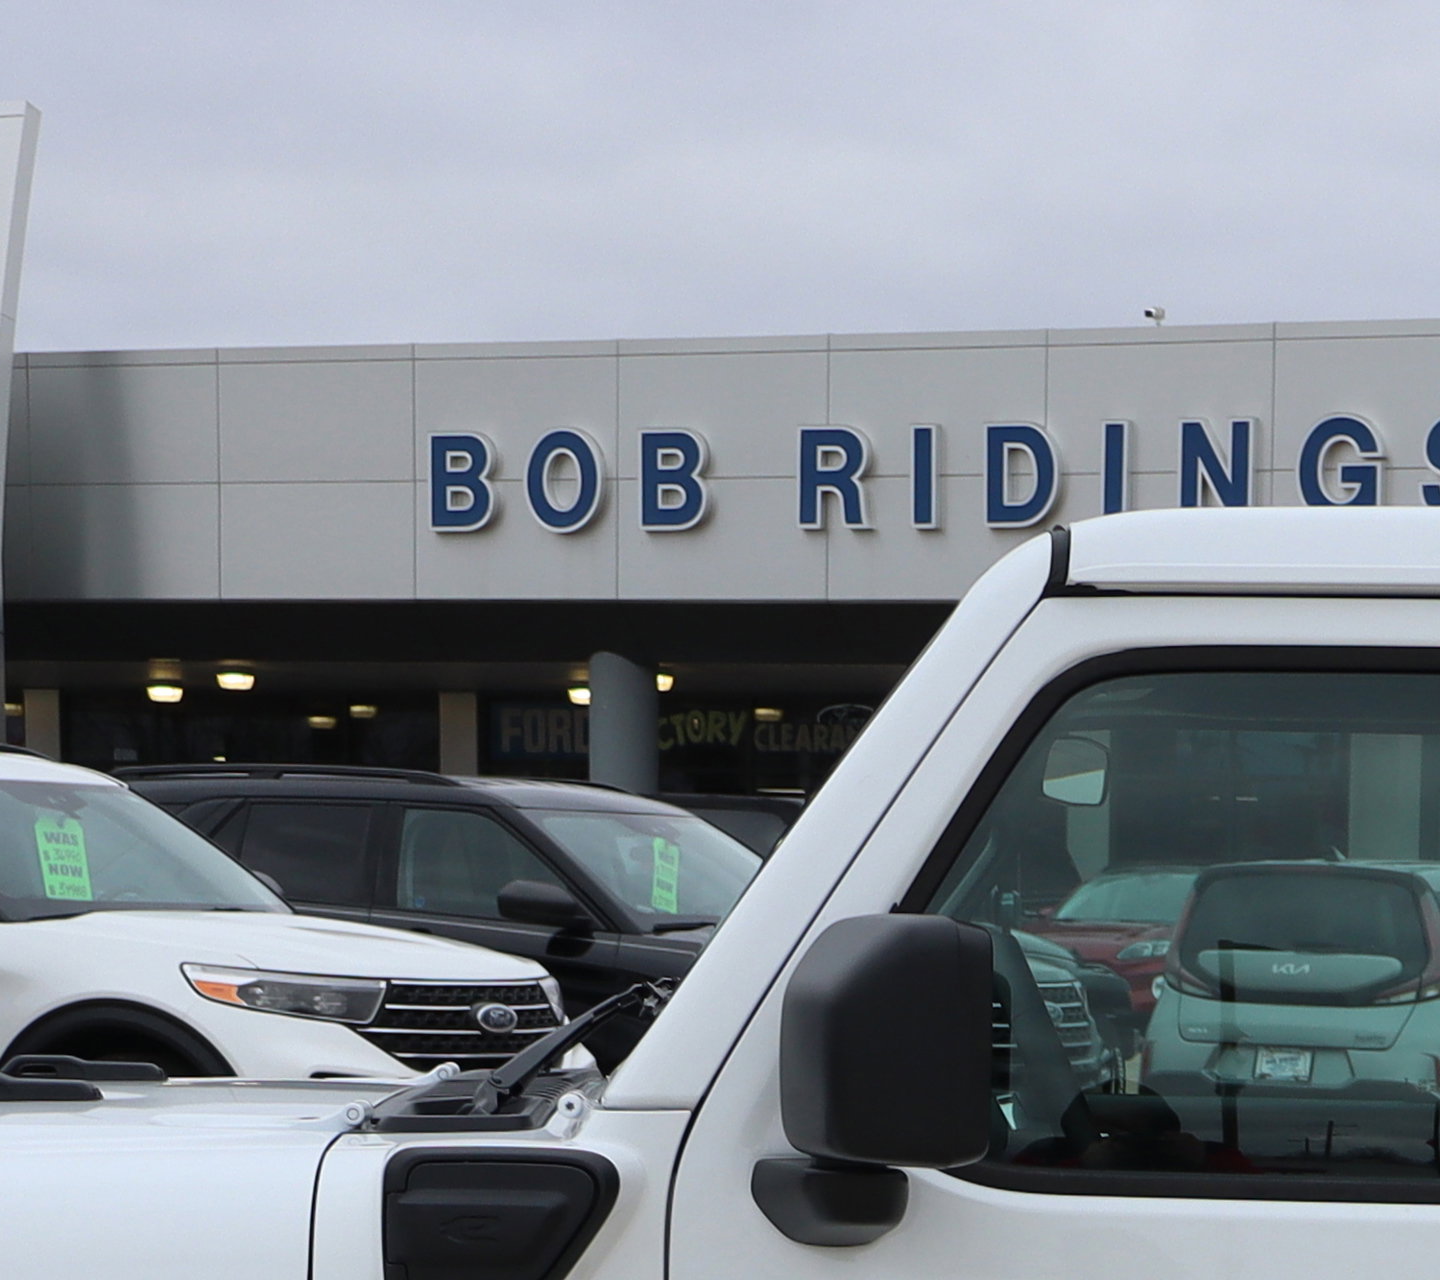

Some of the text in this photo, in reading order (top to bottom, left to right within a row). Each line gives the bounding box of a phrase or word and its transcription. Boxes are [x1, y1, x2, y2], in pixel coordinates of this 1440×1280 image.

[427, 430, 709, 532] BOB
[656, 709, 749, 751] CTORY
[43, 832, 79, 847] WAS
[48, 864, 83, 878] NOW
